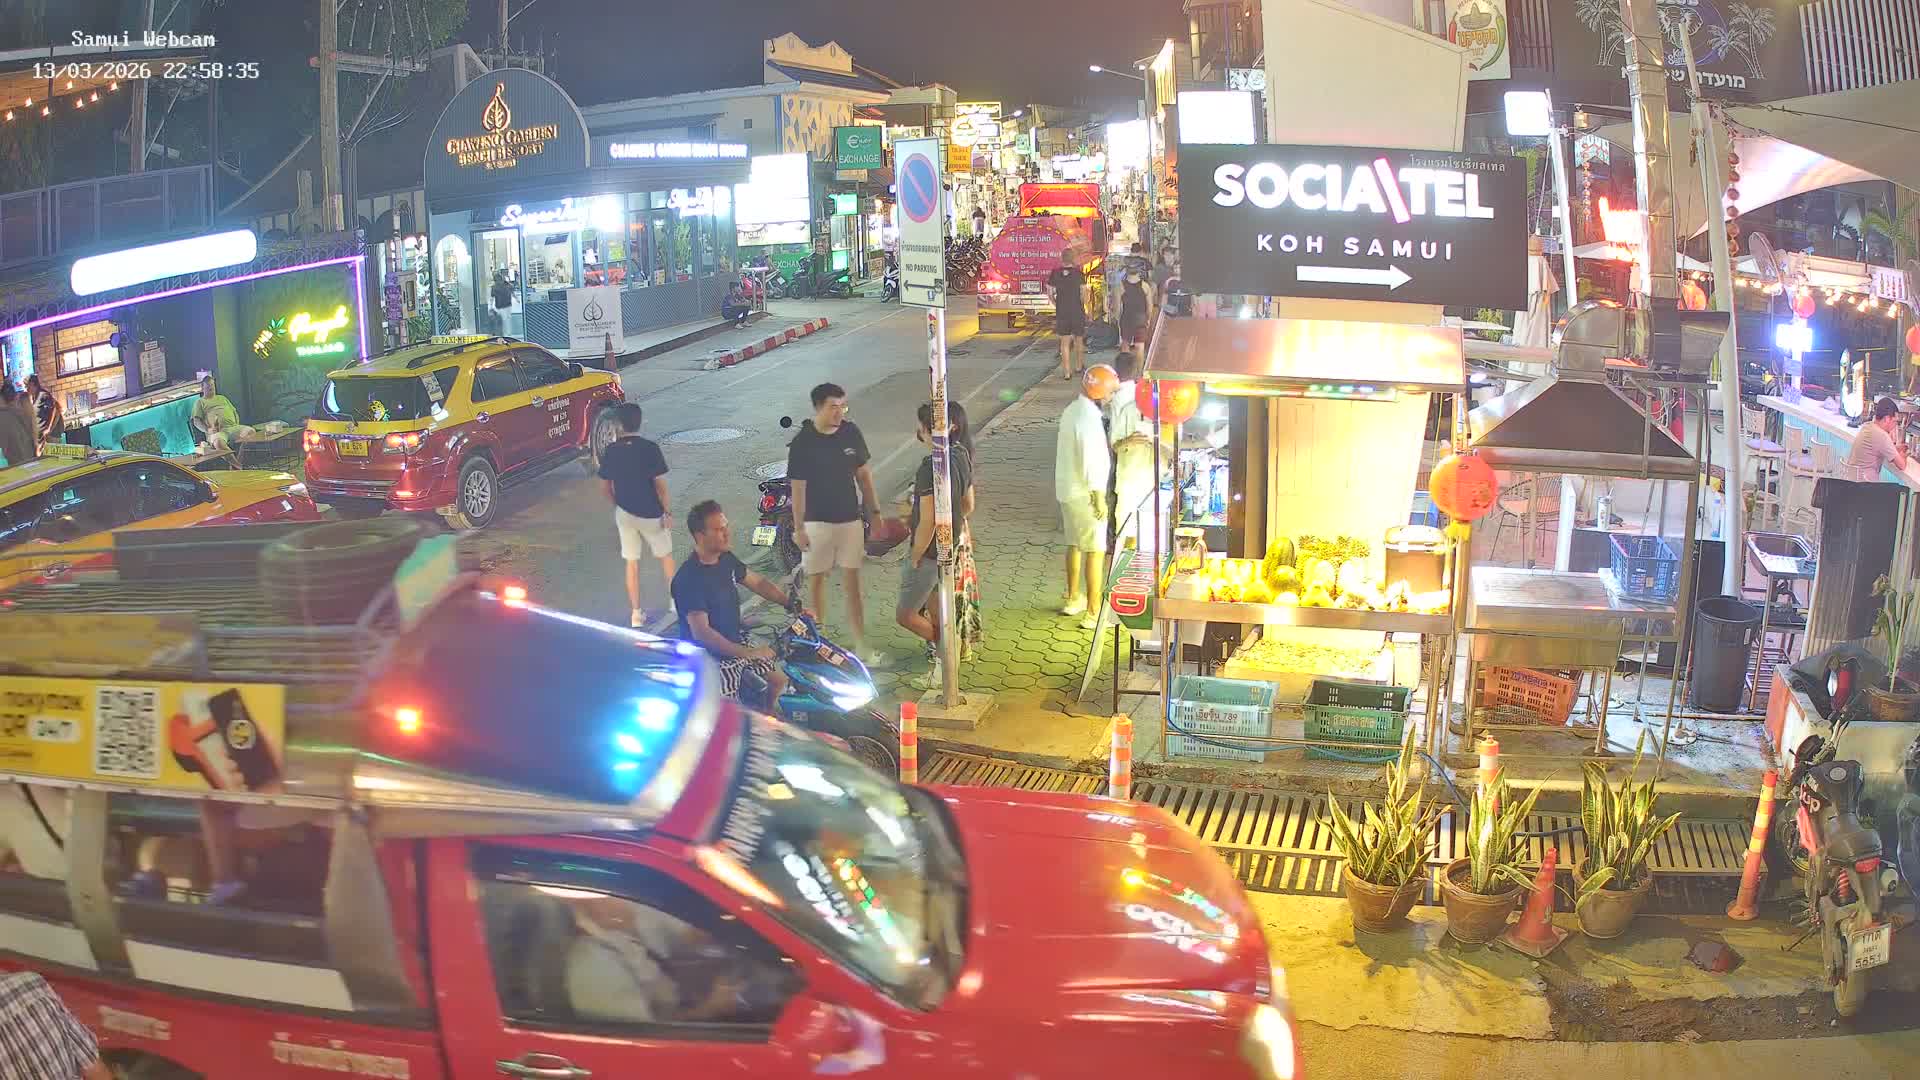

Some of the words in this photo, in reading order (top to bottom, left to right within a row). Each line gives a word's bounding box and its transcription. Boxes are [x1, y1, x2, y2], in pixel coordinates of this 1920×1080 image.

[839, 154, 880, 164] EXCHANGE
[1257, 233, 1323, 254] KOH
[1343, 236, 1452, 260] SAMUI
[905, 263, 914, 272] NO
[914, 263, 937, 274] PARKING
[1224, 712, 1238, 721] 789
